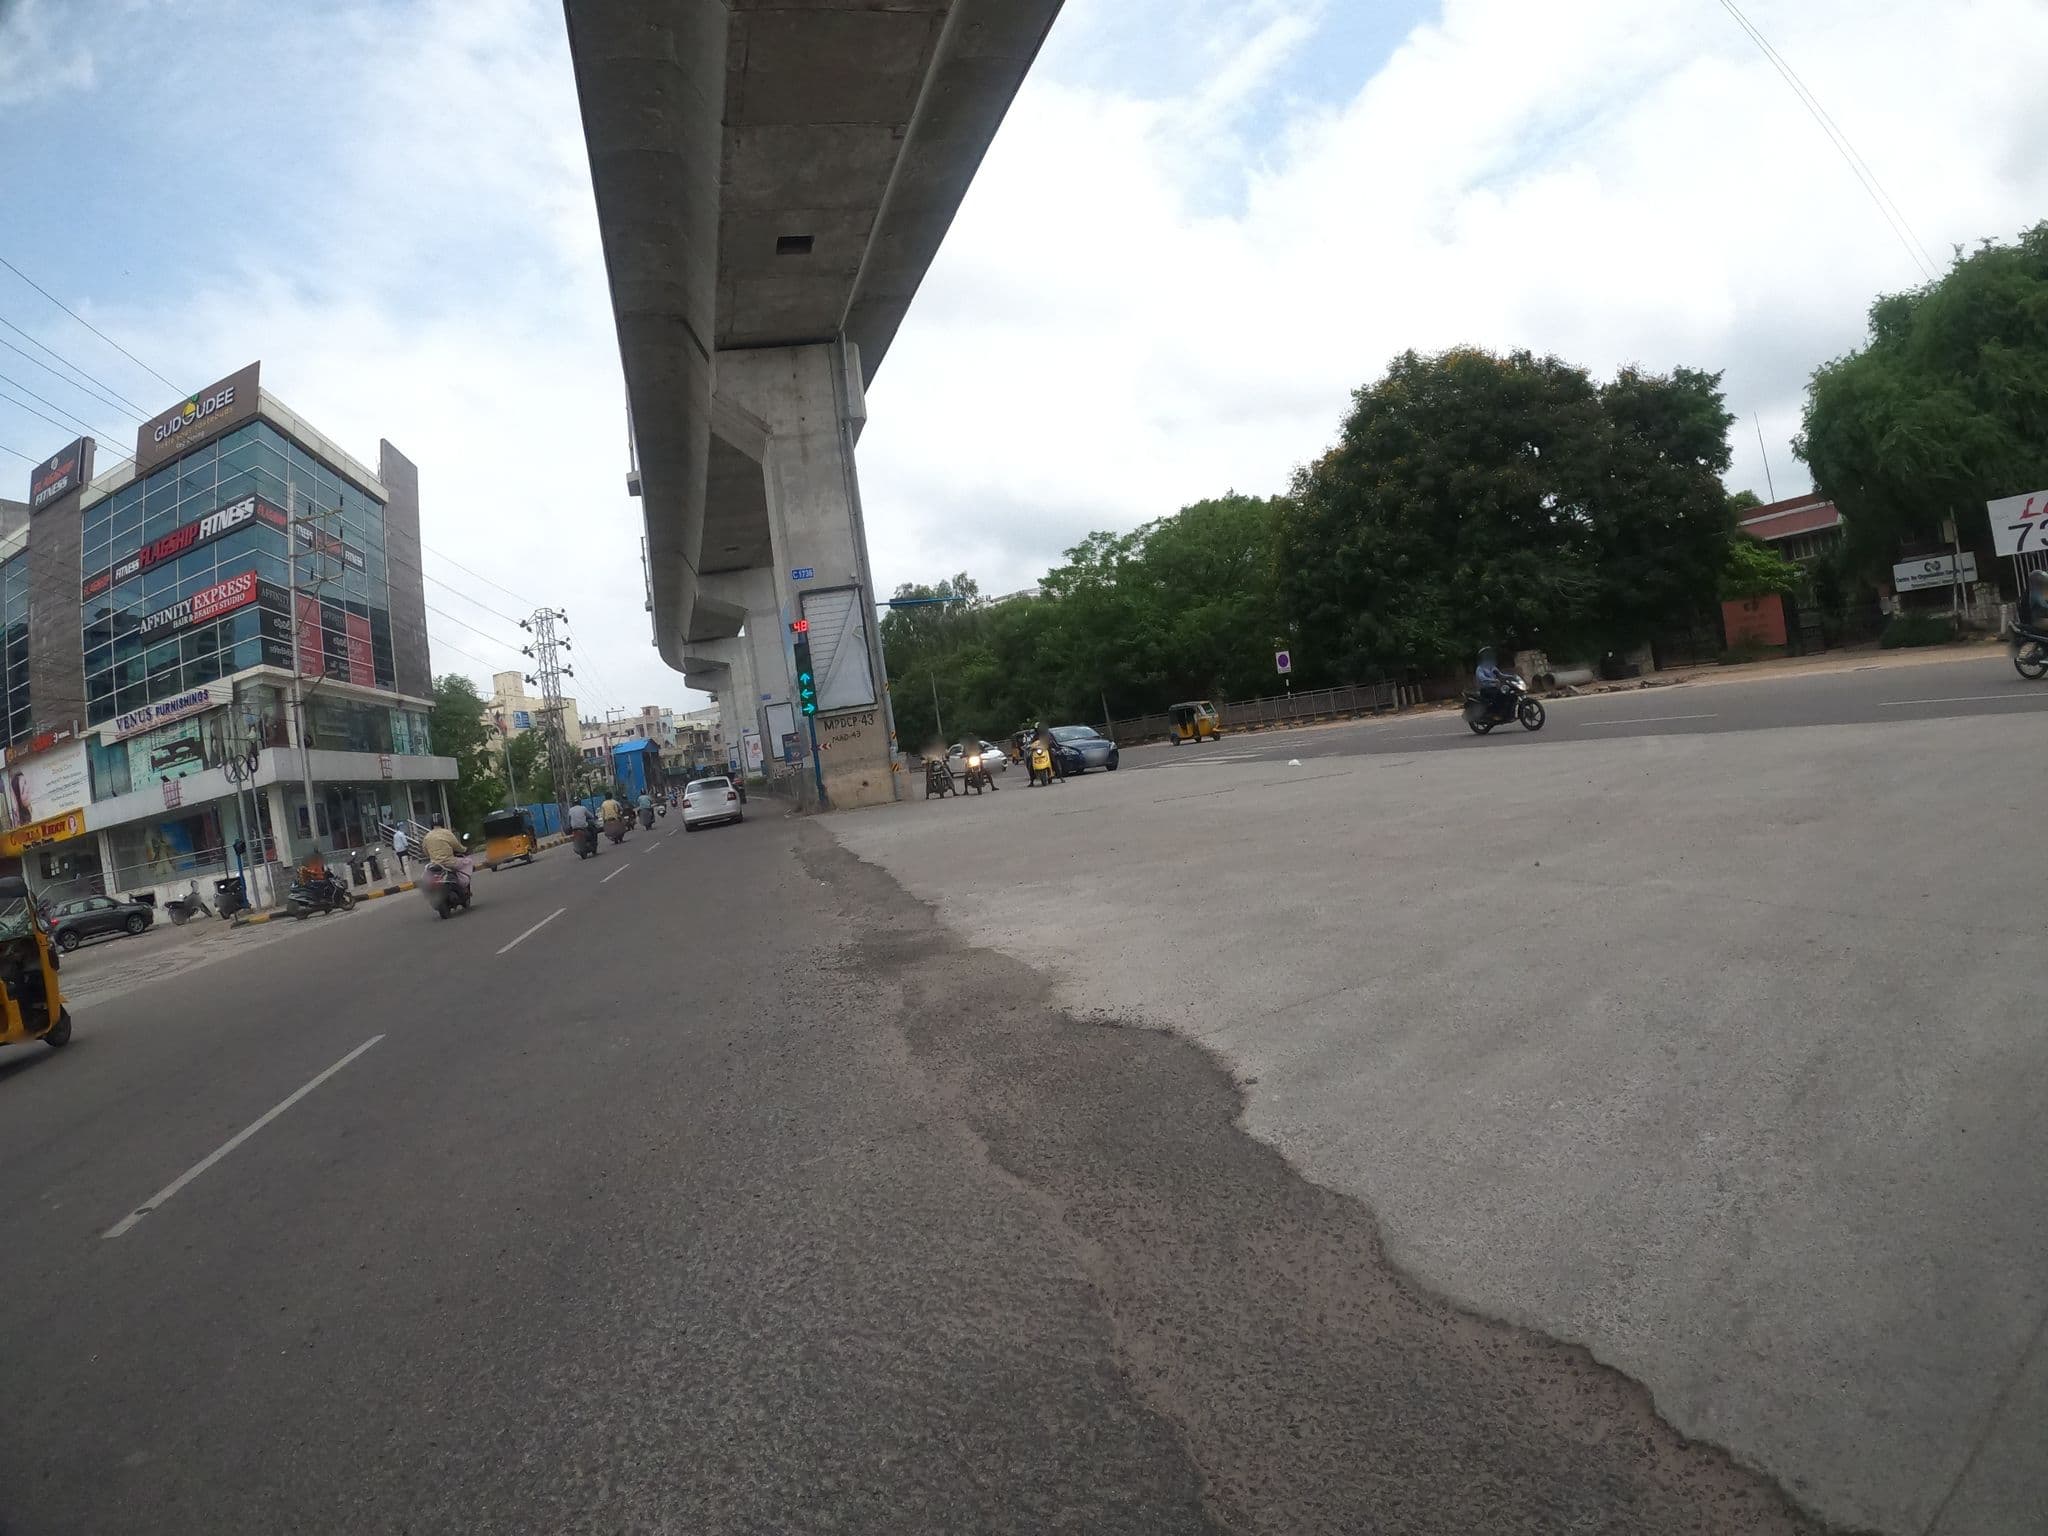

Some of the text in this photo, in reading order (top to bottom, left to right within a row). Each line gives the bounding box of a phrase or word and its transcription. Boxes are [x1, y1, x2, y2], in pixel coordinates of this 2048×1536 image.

[115, 558, 140, 580] FITNESS
[139, 522, 200, 568] FLAGSHIP
[198, 496, 255, 541] FITNESS
[140, 573, 251, 635] AFFINITY EXPRESS
[173, 614, 189, 629] HAIR
[219, 592, 246, 610] STUDIO
[793, 620, 808, 633] 48
[115, 706, 154, 731] VENUS
